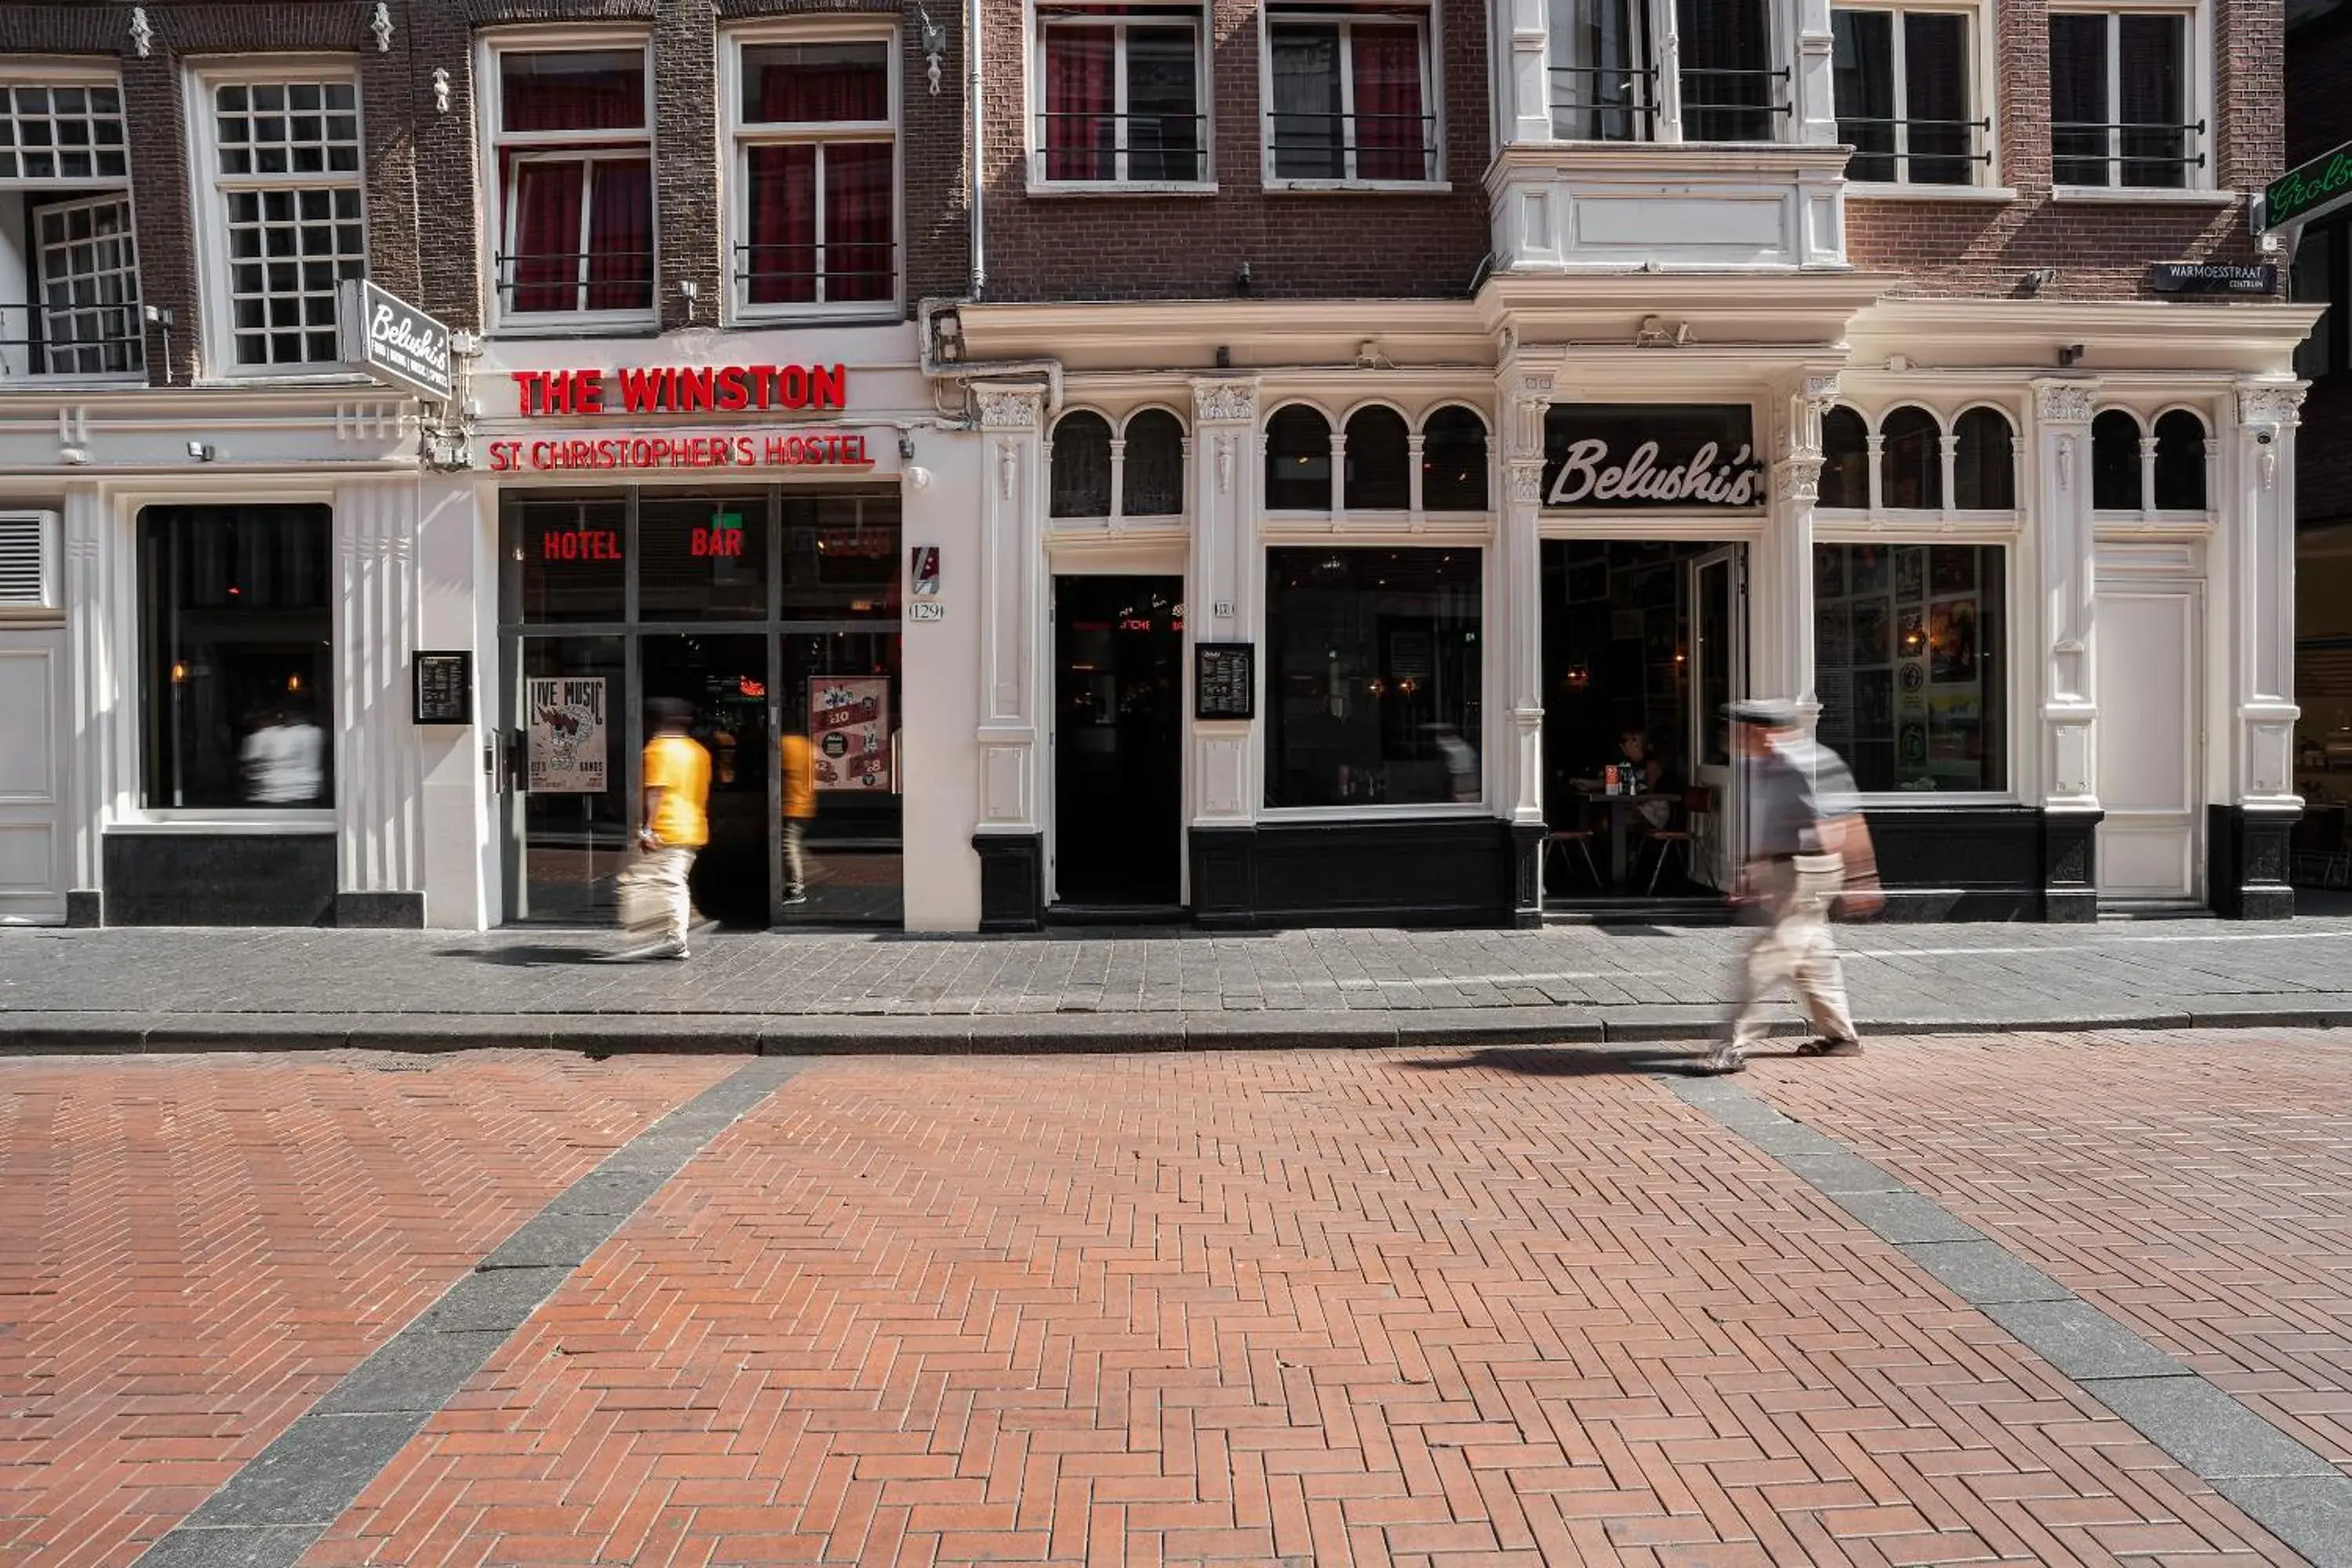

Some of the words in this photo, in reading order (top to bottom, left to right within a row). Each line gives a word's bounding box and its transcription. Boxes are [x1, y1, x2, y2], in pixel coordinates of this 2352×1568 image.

[2269, 153, 2352, 223] Grols
[2169, 265, 2262, 278] WARMOESSTRAAT
[2229, 280, 2263, 289] CENTRUM
[371, 303, 446, 371] Belushi's
[510, 369, 604, 417] THE
[618, 363, 848, 413] WINSTON
[532, 436, 756, 470] CHRISTOPHER'S
[764, 435, 876, 466] HOSTEL
[1548, 438, 1756, 505] Belushi's
[543, 531, 622, 560] HOTEL
[691, 528, 742, 557] BAR
[915, 604, 939, 619] 129
[531, 681, 557, 725] LIVE
[564, 681, 603, 725] MUSIC
